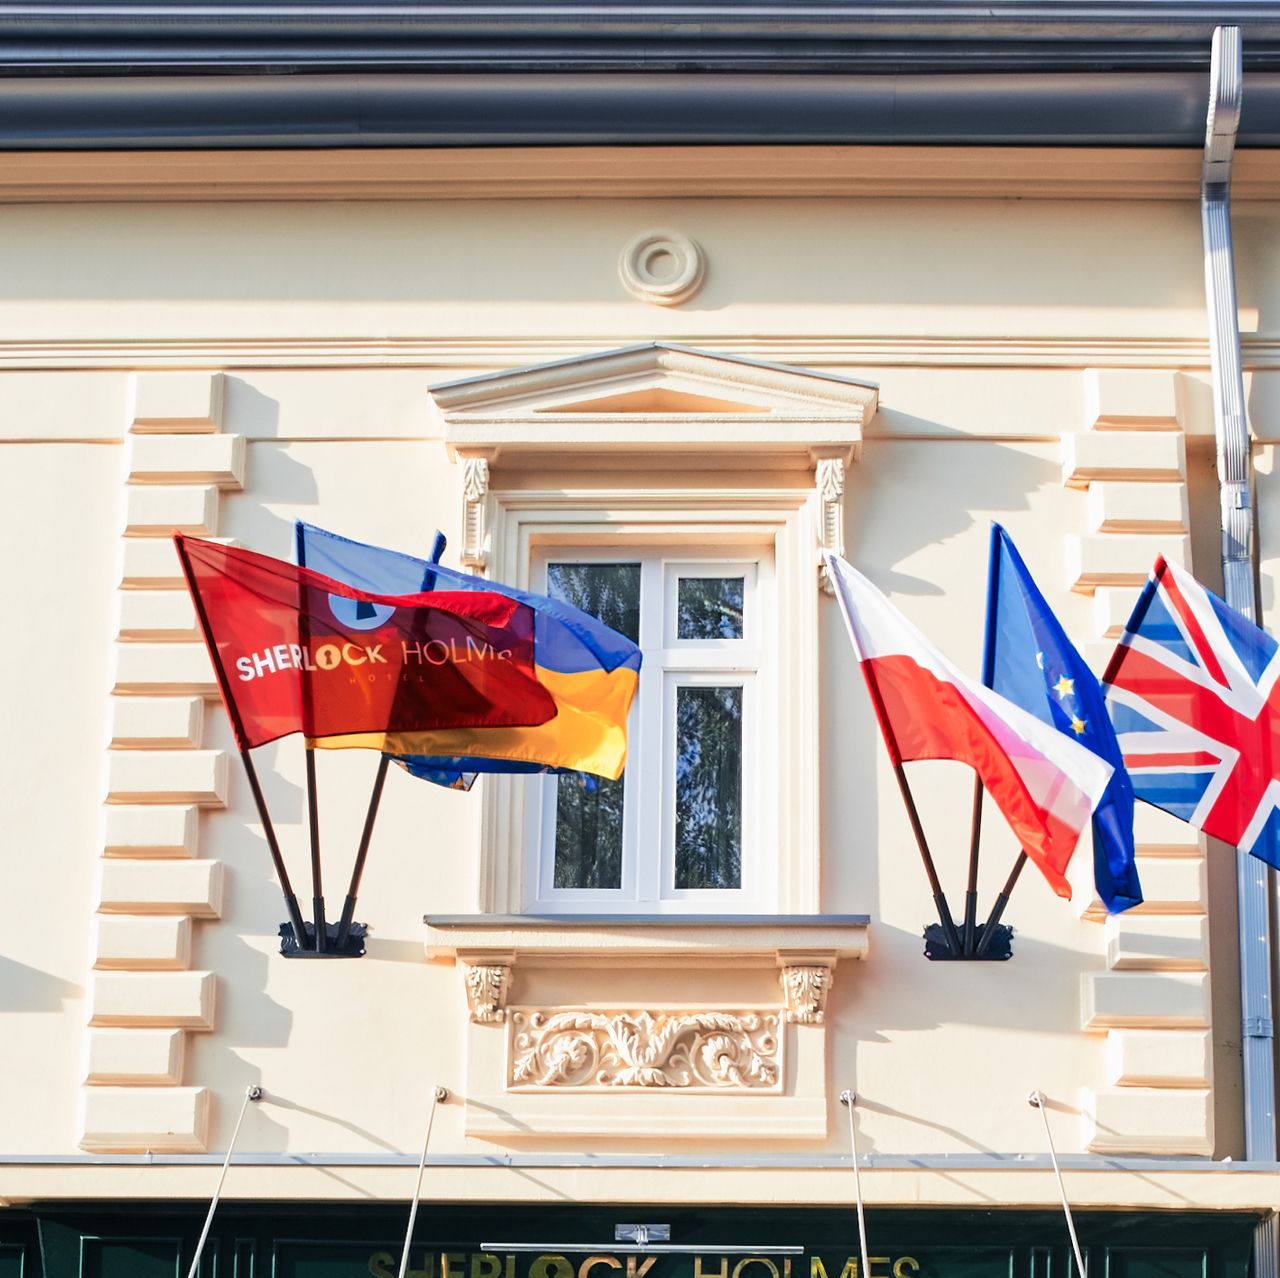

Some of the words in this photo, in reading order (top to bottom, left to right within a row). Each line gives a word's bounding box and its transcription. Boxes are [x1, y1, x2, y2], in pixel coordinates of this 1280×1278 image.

[236, 643, 387, 682] SHERLOCK
[402, 635, 513, 666] HOLM
[349, 673, 424, 685] HOTEL
